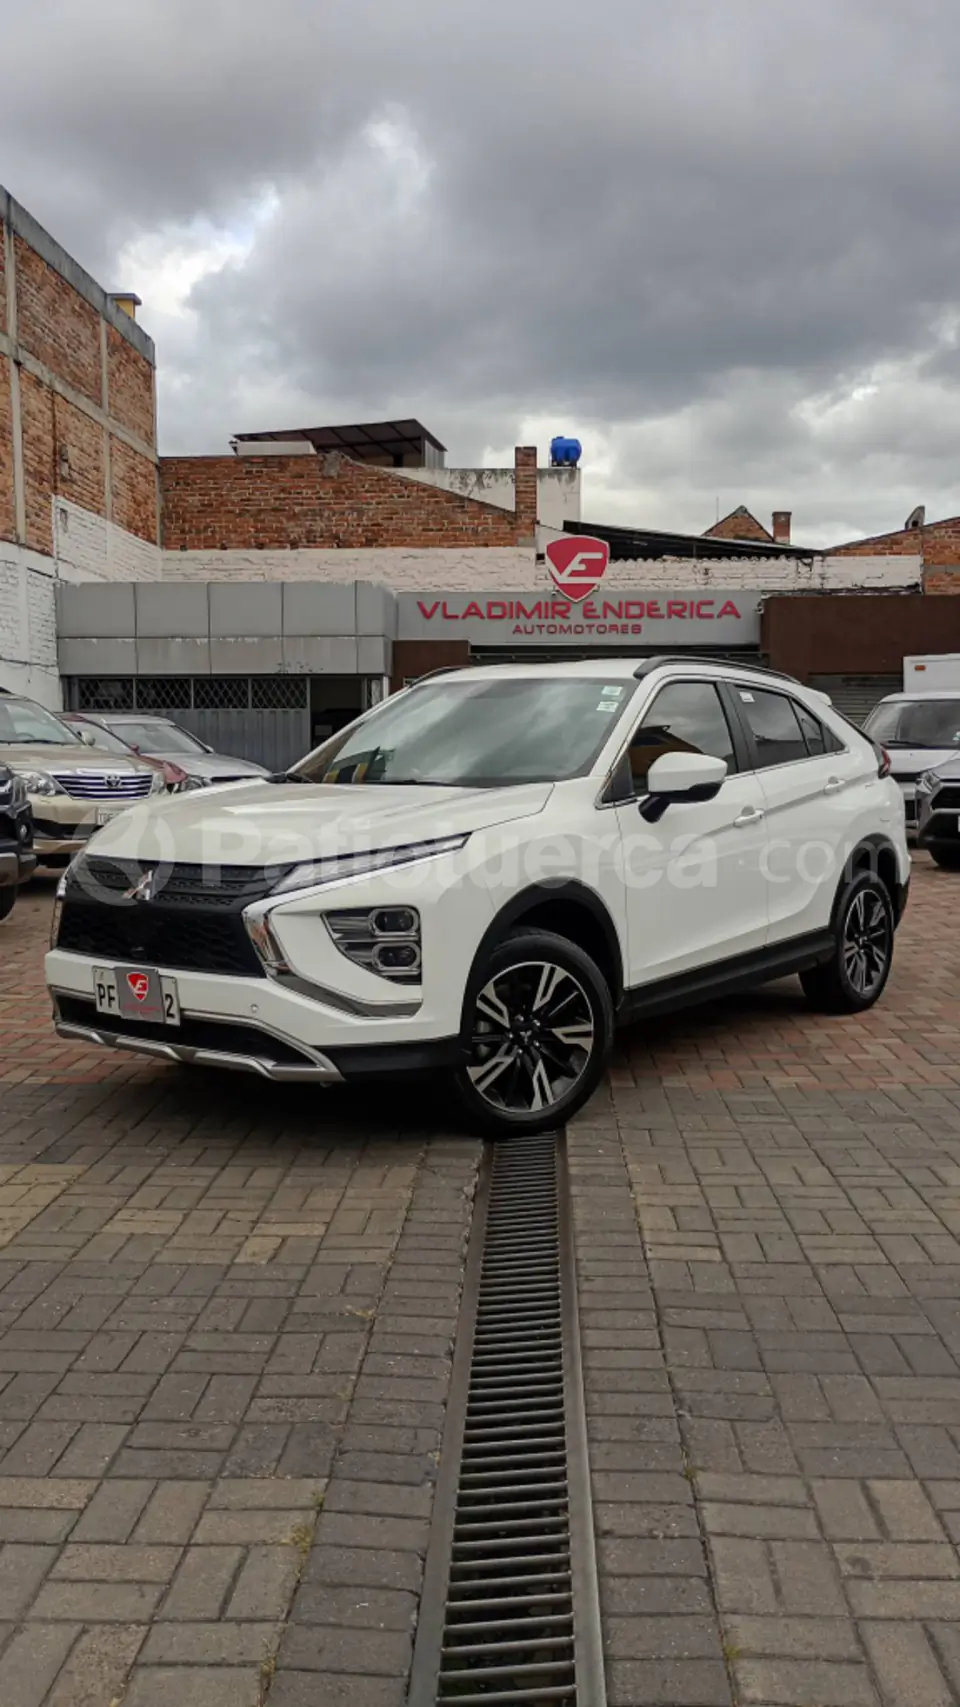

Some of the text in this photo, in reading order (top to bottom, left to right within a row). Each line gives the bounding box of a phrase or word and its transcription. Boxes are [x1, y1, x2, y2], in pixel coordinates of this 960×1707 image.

[417, 600, 741, 620] VLADIMIR ENDERICA
[512, 624, 643, 635] AUTOMOTORES
